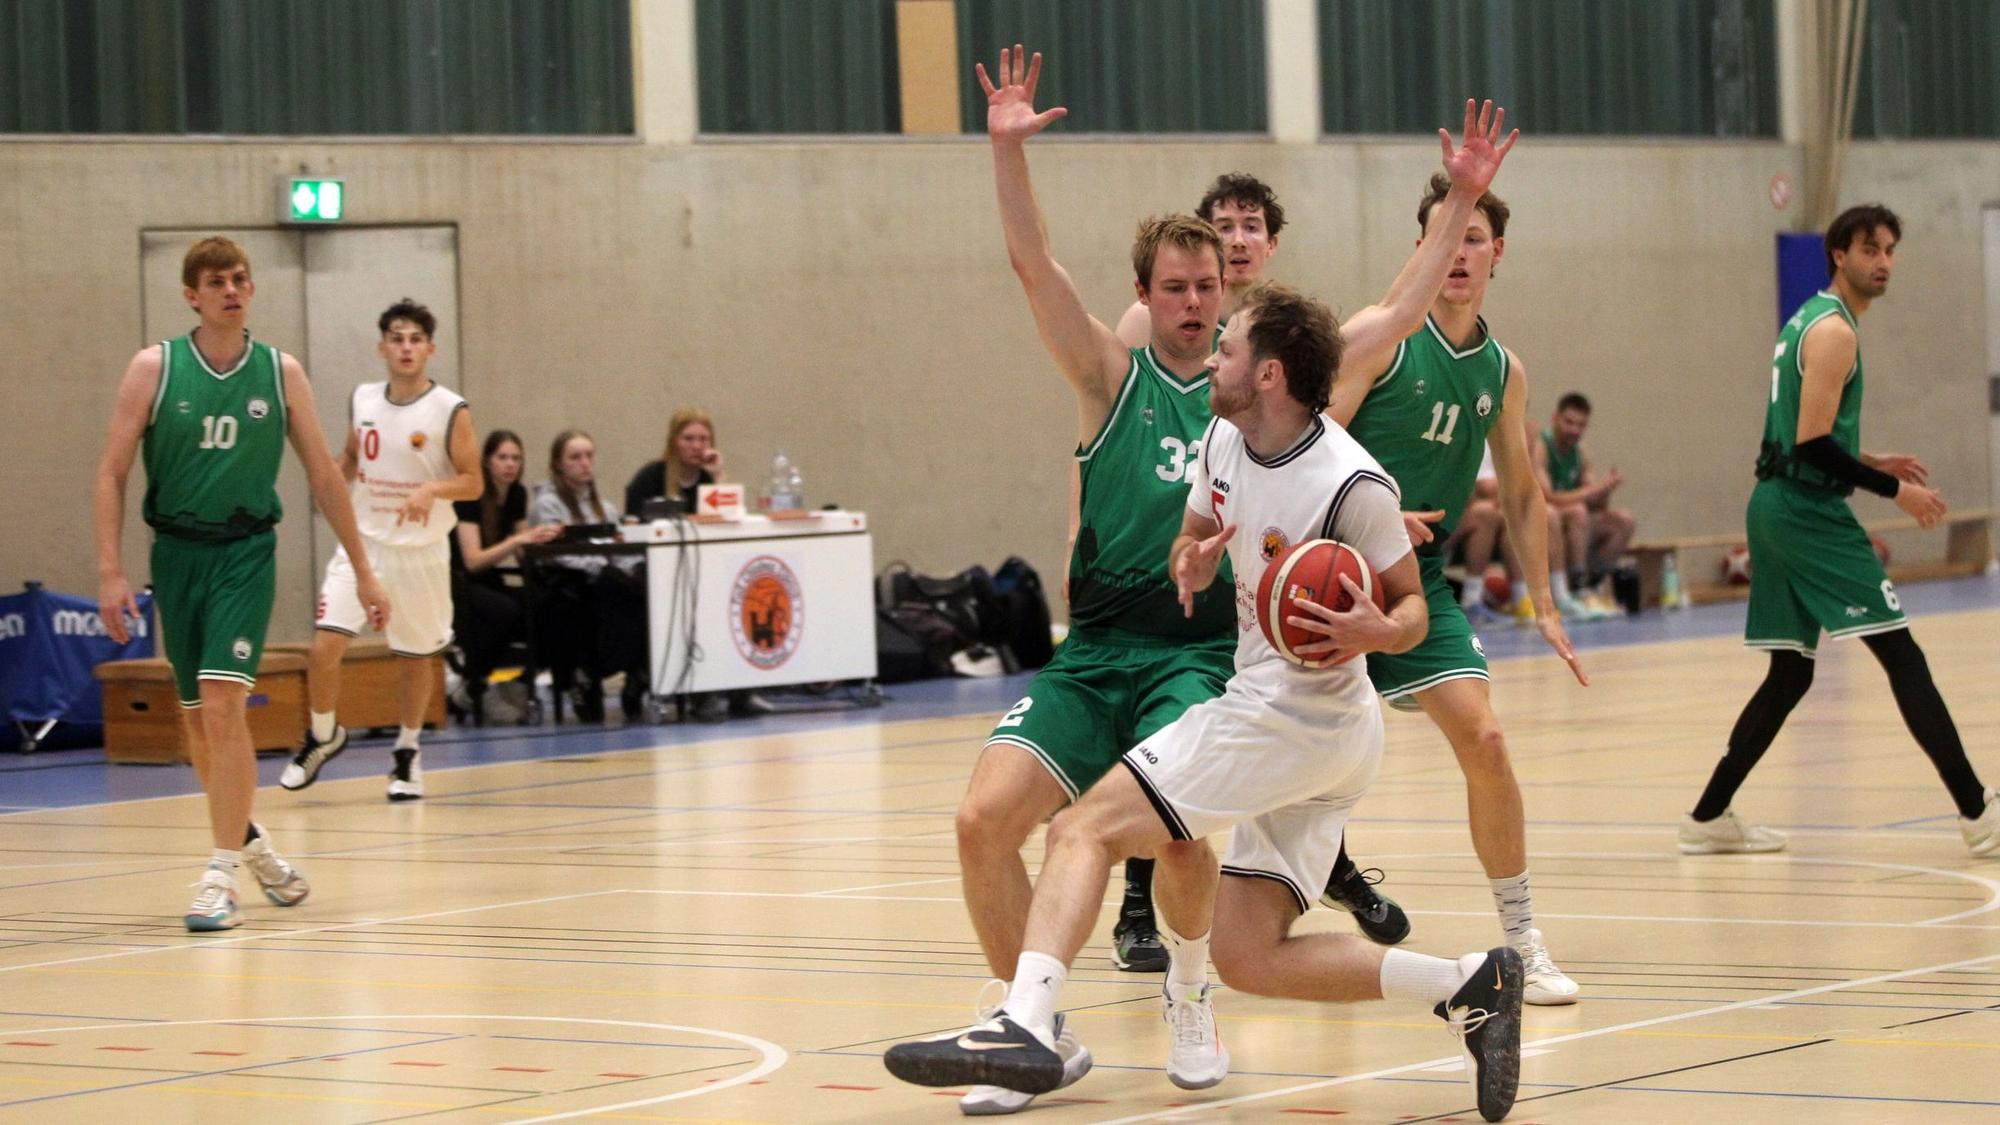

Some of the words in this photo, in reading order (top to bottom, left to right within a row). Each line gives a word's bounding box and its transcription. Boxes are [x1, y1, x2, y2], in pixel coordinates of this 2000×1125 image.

[199, 415, 239, 450] 10
[1420, 401, 1461, 445] 11
[1880, 579, 1901, 612] 6
